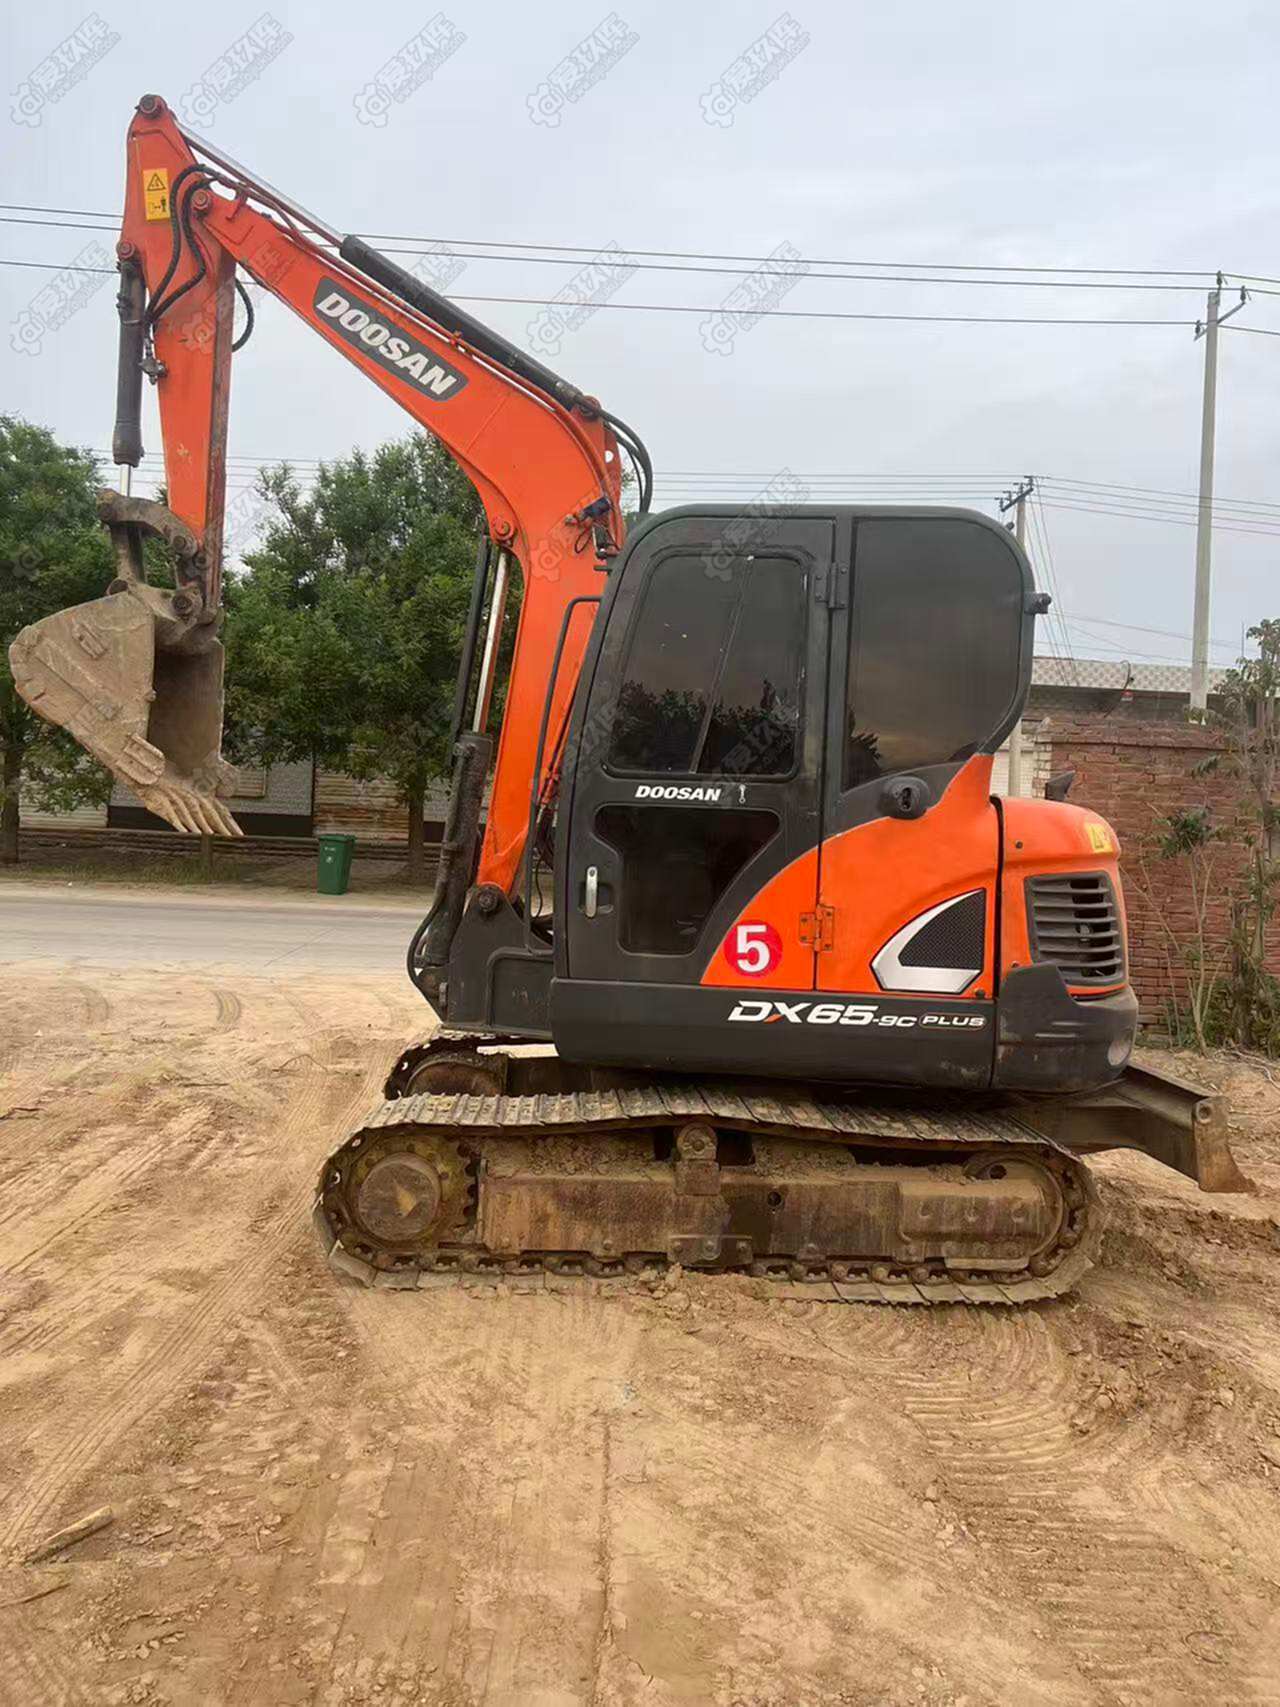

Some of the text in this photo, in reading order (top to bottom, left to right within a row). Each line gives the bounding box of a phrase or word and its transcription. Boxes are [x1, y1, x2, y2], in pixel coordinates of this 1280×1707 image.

[316, 292, 457, 395] DOOSAN
[635, 785, 721, 801] DOOSAN
[737, 925, 770, 973] 5
[922, 1014, 985, 1027] PLUS
